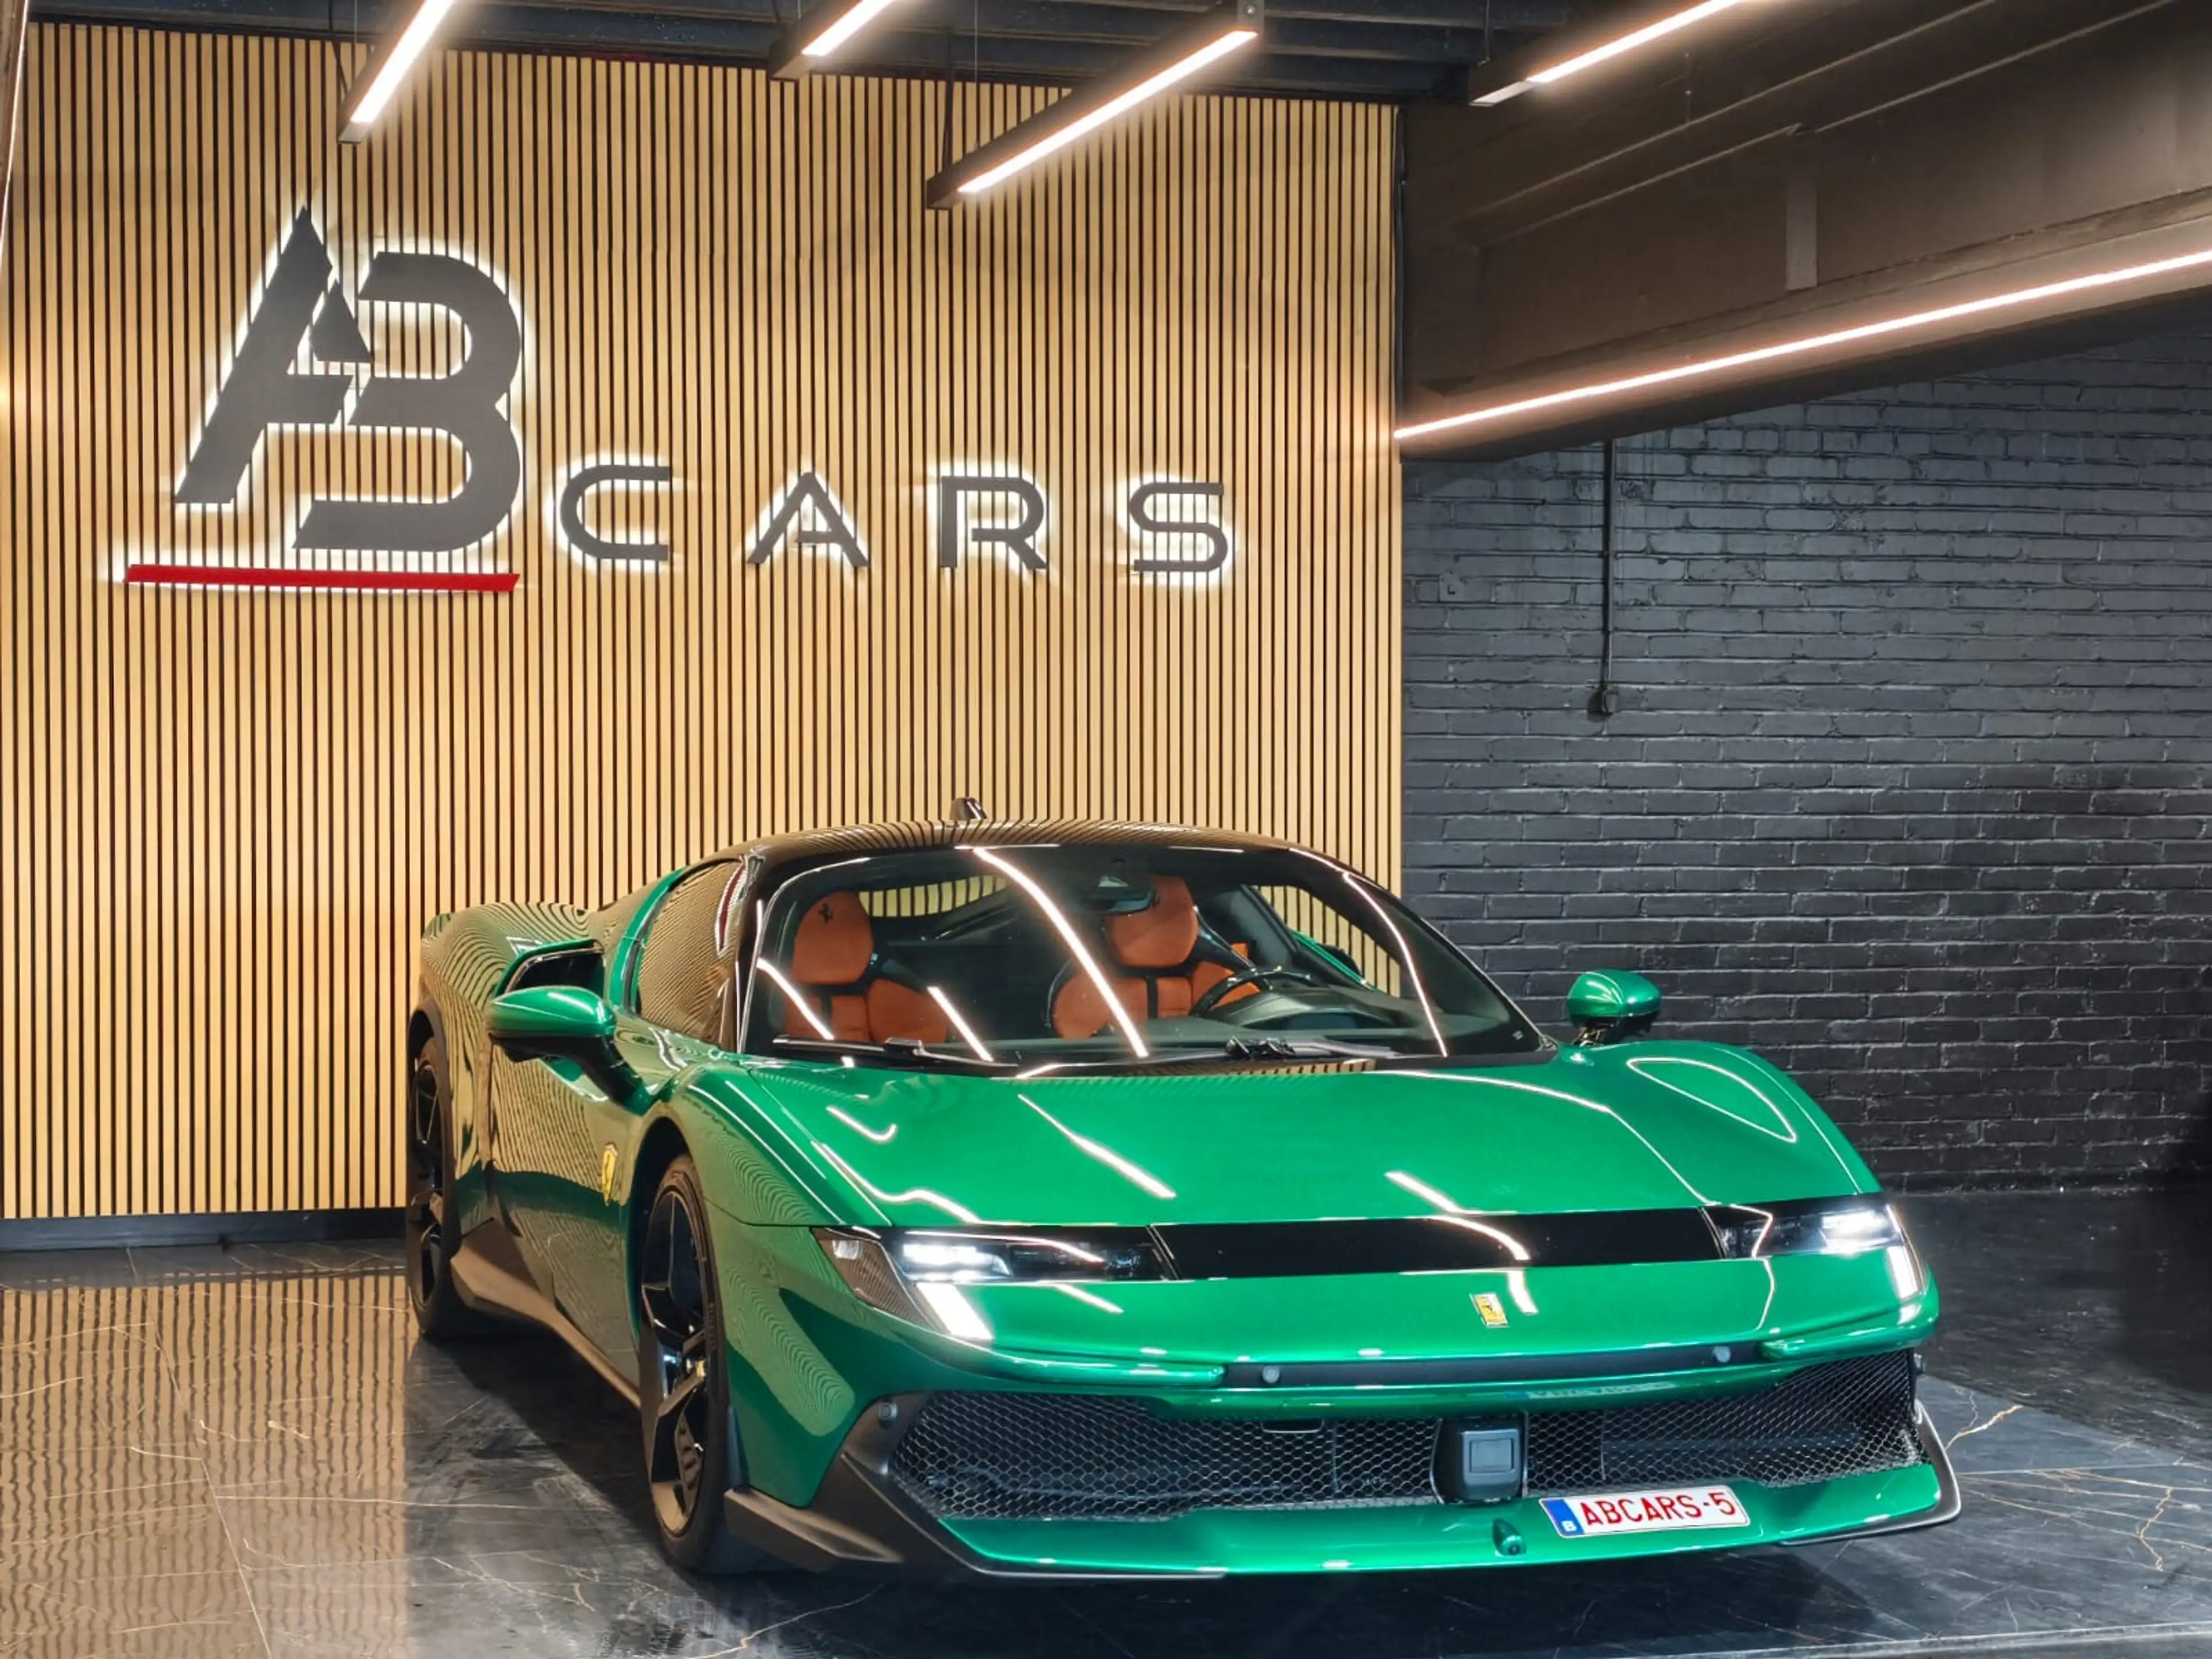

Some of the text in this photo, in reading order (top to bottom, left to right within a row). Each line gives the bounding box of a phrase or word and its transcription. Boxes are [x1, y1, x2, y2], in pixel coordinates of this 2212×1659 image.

[174, 205, 1228, 571] AB CARS
[1561, 1520, 1577, 1532] B
